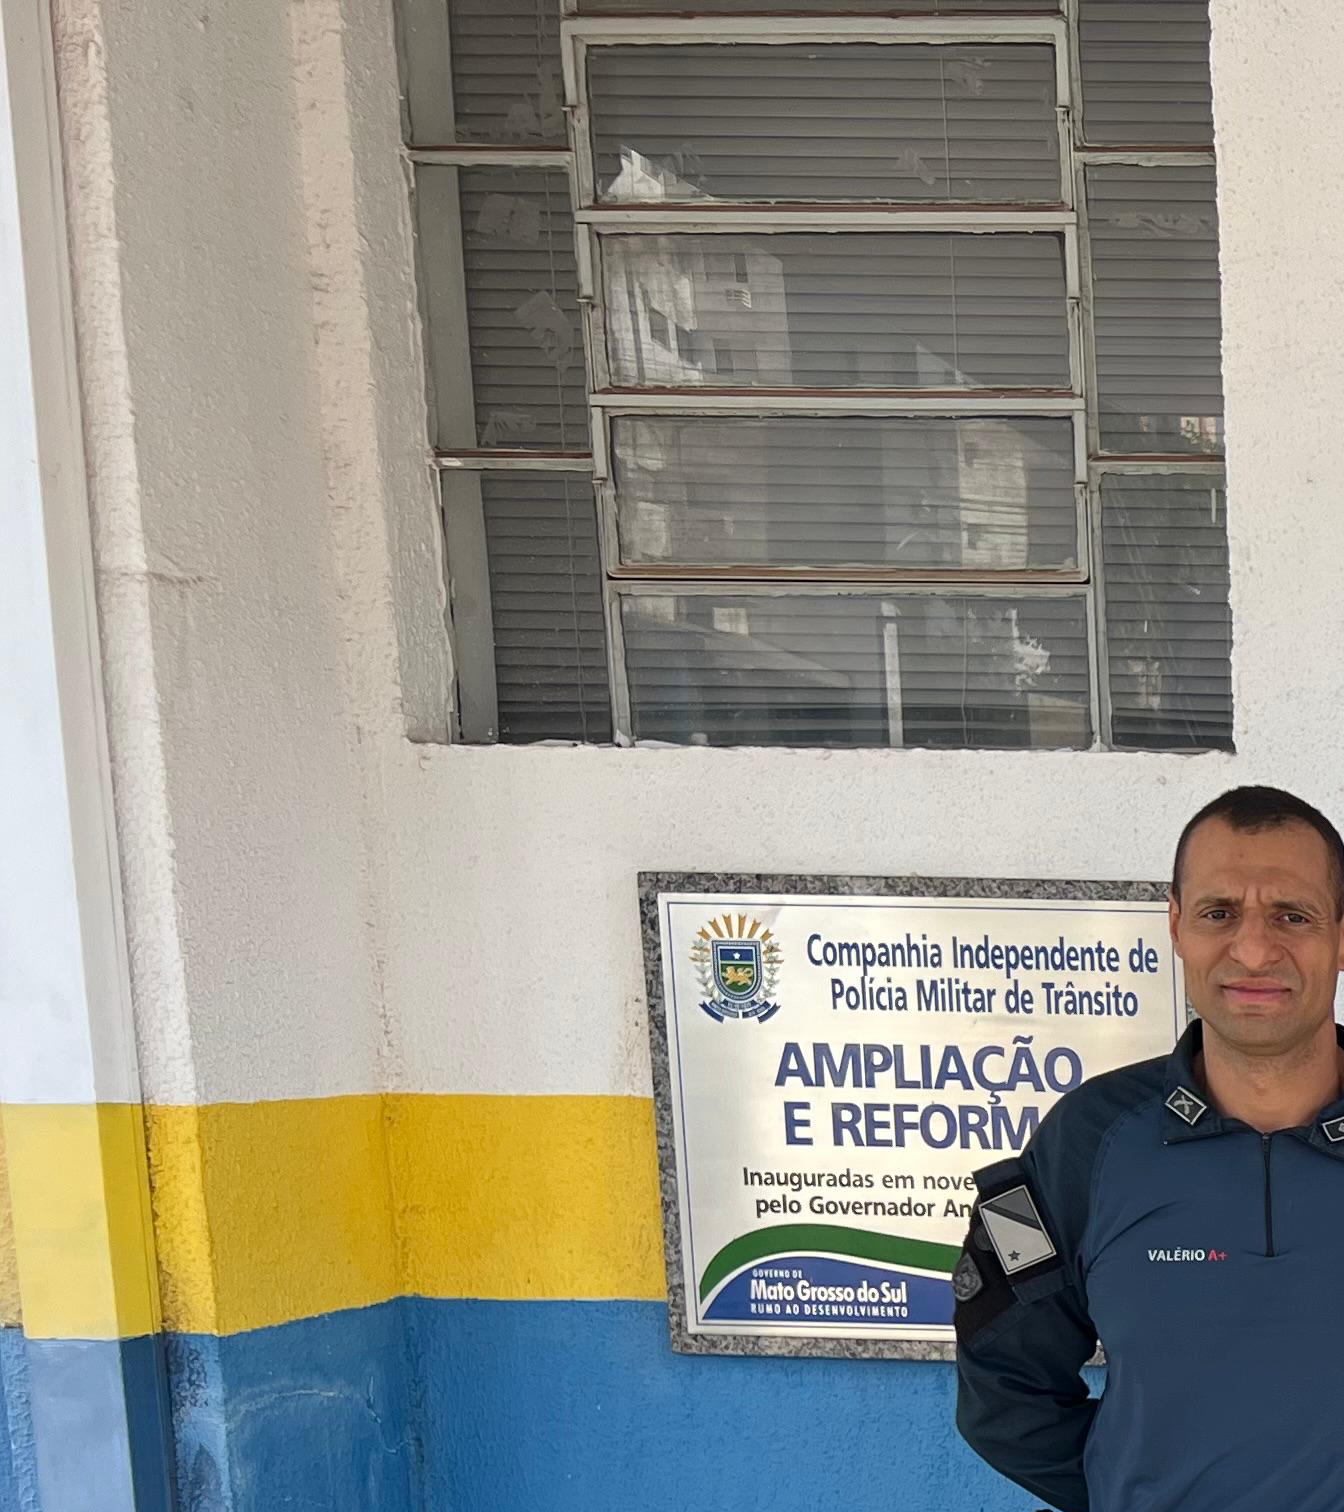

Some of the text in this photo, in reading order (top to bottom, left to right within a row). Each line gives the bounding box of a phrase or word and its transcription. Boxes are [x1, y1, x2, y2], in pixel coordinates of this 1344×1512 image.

[807, 933, 1159, 978] Companhia Independente de
[831, 976, 1138, 1016] Polícia Militar de Trânsito
[774, 1035, 1083, 1105] AMPLIAÇÃO
[784, 1101, 1039, 1150] E REFORM
[743, 1167, 976, 1191] Inauguradas em nove
[755, 1194, 972, 1218] pelo Governador An
[1147, 1246, 1228, 1261] VALÉRIO A+
[752, 1269, 790, 1278] GOVERNO
[751, 1279, 908, 1303] Mato Grosso do Sul
[751, 1303, 908, 1318] RUMO AO DESENVOLVIMENTO
